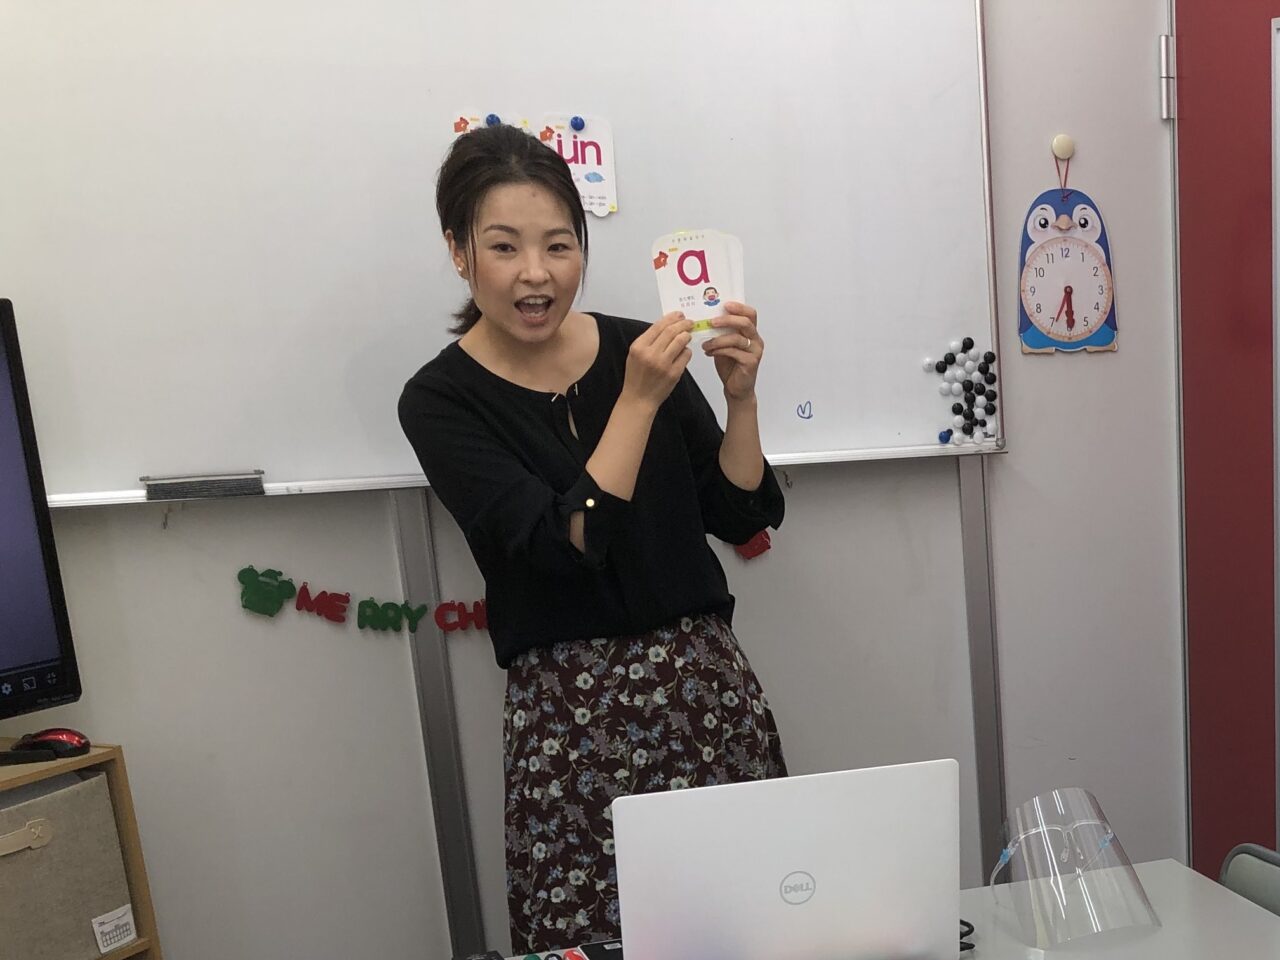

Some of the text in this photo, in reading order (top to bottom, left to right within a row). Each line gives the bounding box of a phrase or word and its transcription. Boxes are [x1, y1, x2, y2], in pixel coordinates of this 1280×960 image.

[1061, 248, 1070, 258] 12
[1081, 252, 1084, 262] 1
[1046, 254, 1054, 264] 11
[677, 250, 710, 287] a
[1035, 268, 1045, 277] 10
[1092, 267, 1099, 276] 2
[1030, 286, 1036, 296] 9
[1098, 285, 1104, 295] 3
[1036, 304, 1041, 313] 8
[1094, 302, 1100, 312] 4
[1050, 317, 1056, 328] 7
[1083, 317, 1089, 326] 5
[783, 882, 813, 895] DELL
